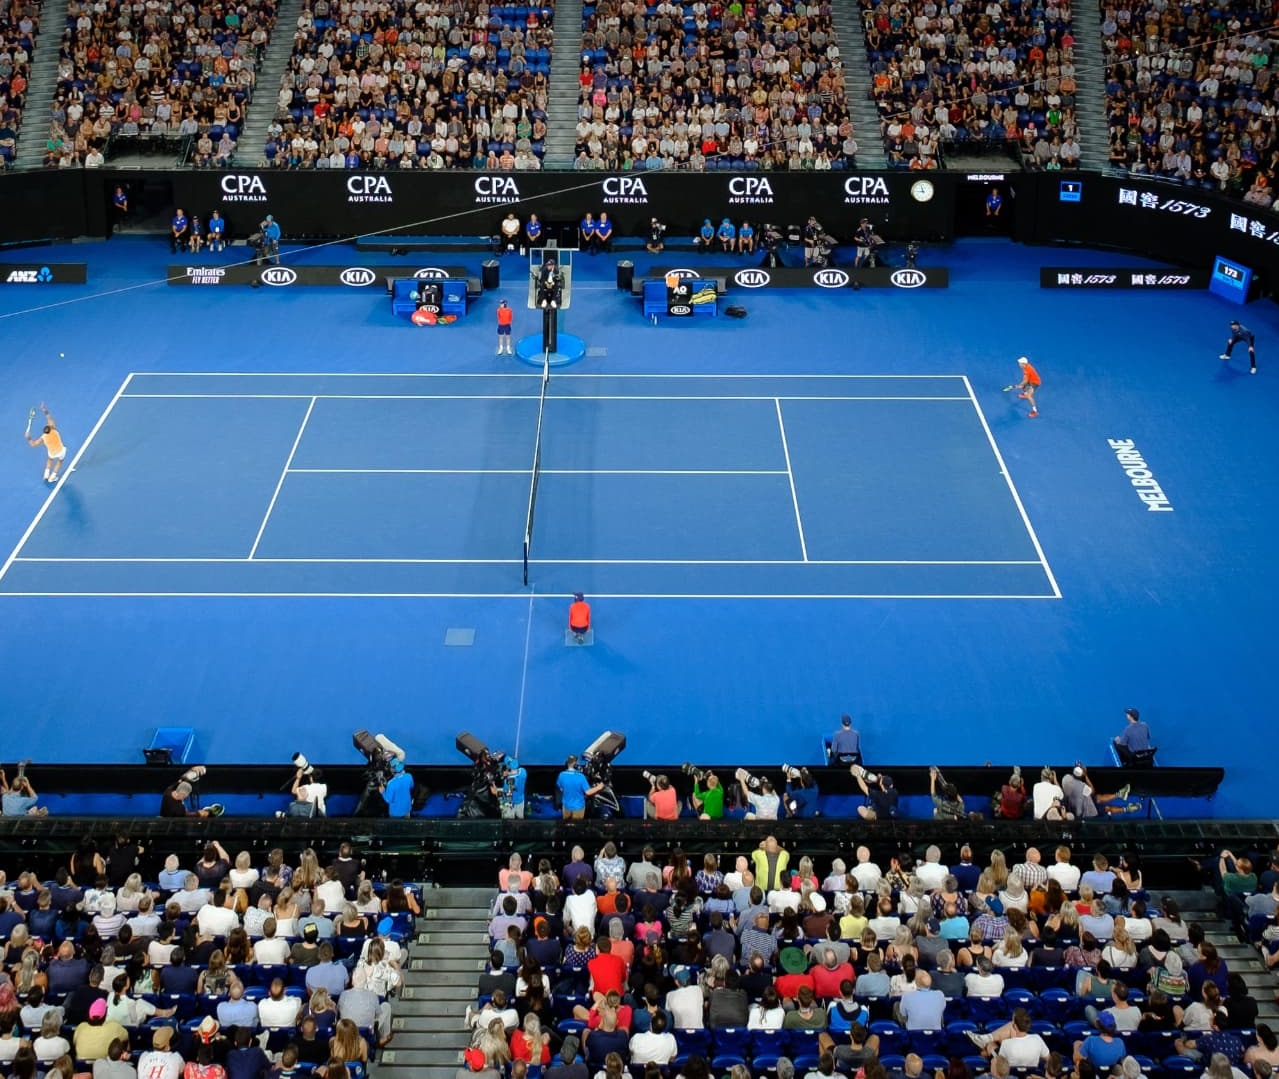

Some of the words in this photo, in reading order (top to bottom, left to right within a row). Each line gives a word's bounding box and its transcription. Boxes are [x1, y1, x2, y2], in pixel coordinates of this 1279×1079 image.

[221, 175, 266, 194] CPA
[347, 176, 392, 194] CPA
[475, 176, 520, 195] CPA
[603, 177, 648, 195] CPA
[729, 177, 773, 195] CPA
[845, 177, 889, 195] CPA
[6, 271, 38, 282] ANZ
[186, 267, 225, 276] Emirates
[268, 272, 291, 282] KIA
[347, 272, 369, 282] KIA
[741, 273, 764, 283] KIA
[820, 273, 842, 283] KIA
[898, 273, 920, 283] KIA
[1107, 438, 1174, 512] MELBOURNE
